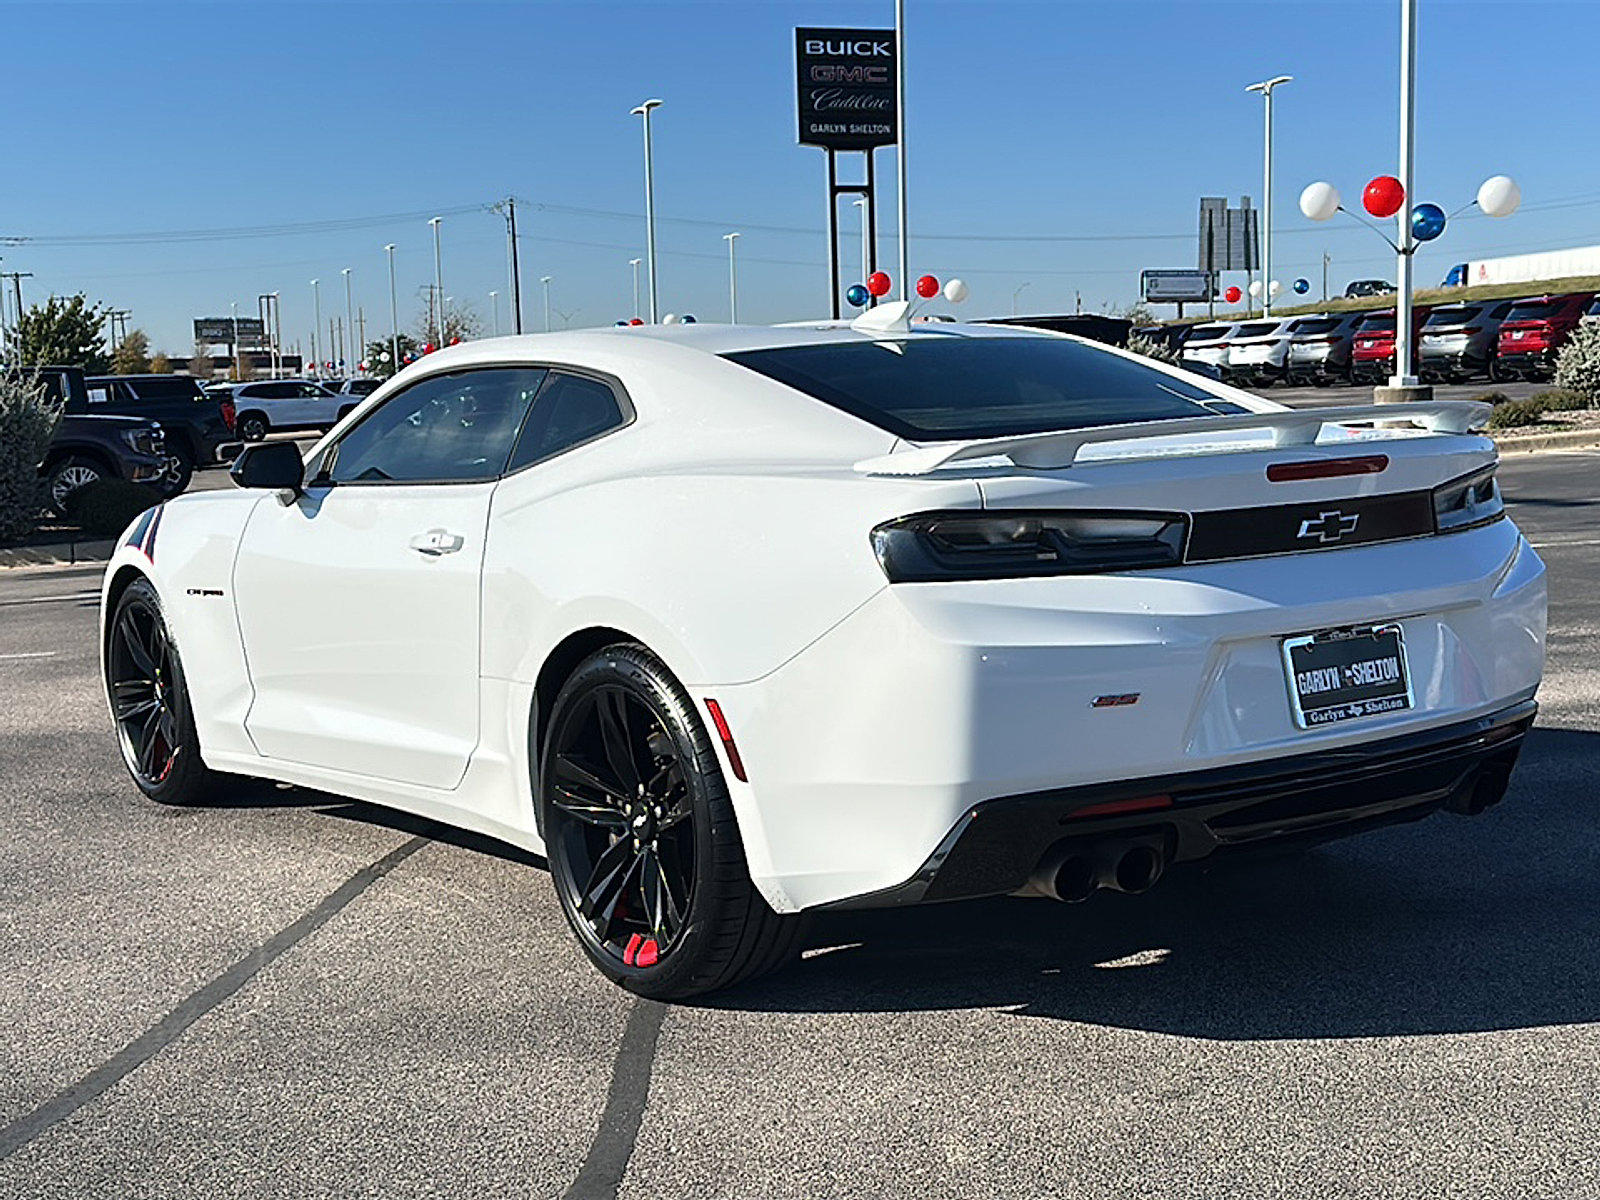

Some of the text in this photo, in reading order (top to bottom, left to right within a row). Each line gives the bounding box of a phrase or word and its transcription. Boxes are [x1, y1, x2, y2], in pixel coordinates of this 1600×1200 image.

[805, 40, 891, 56] BUICK
[810, 65, 888, 82] GMC
[810, 88, 890, 111] Cadillac
[810, 123, 891, 134] GARLYN SHELTON
[1297, 656, 1400, 695] GARLYN SHELTON
[1310, 699, 1403, 723] Garlyn Shelton
